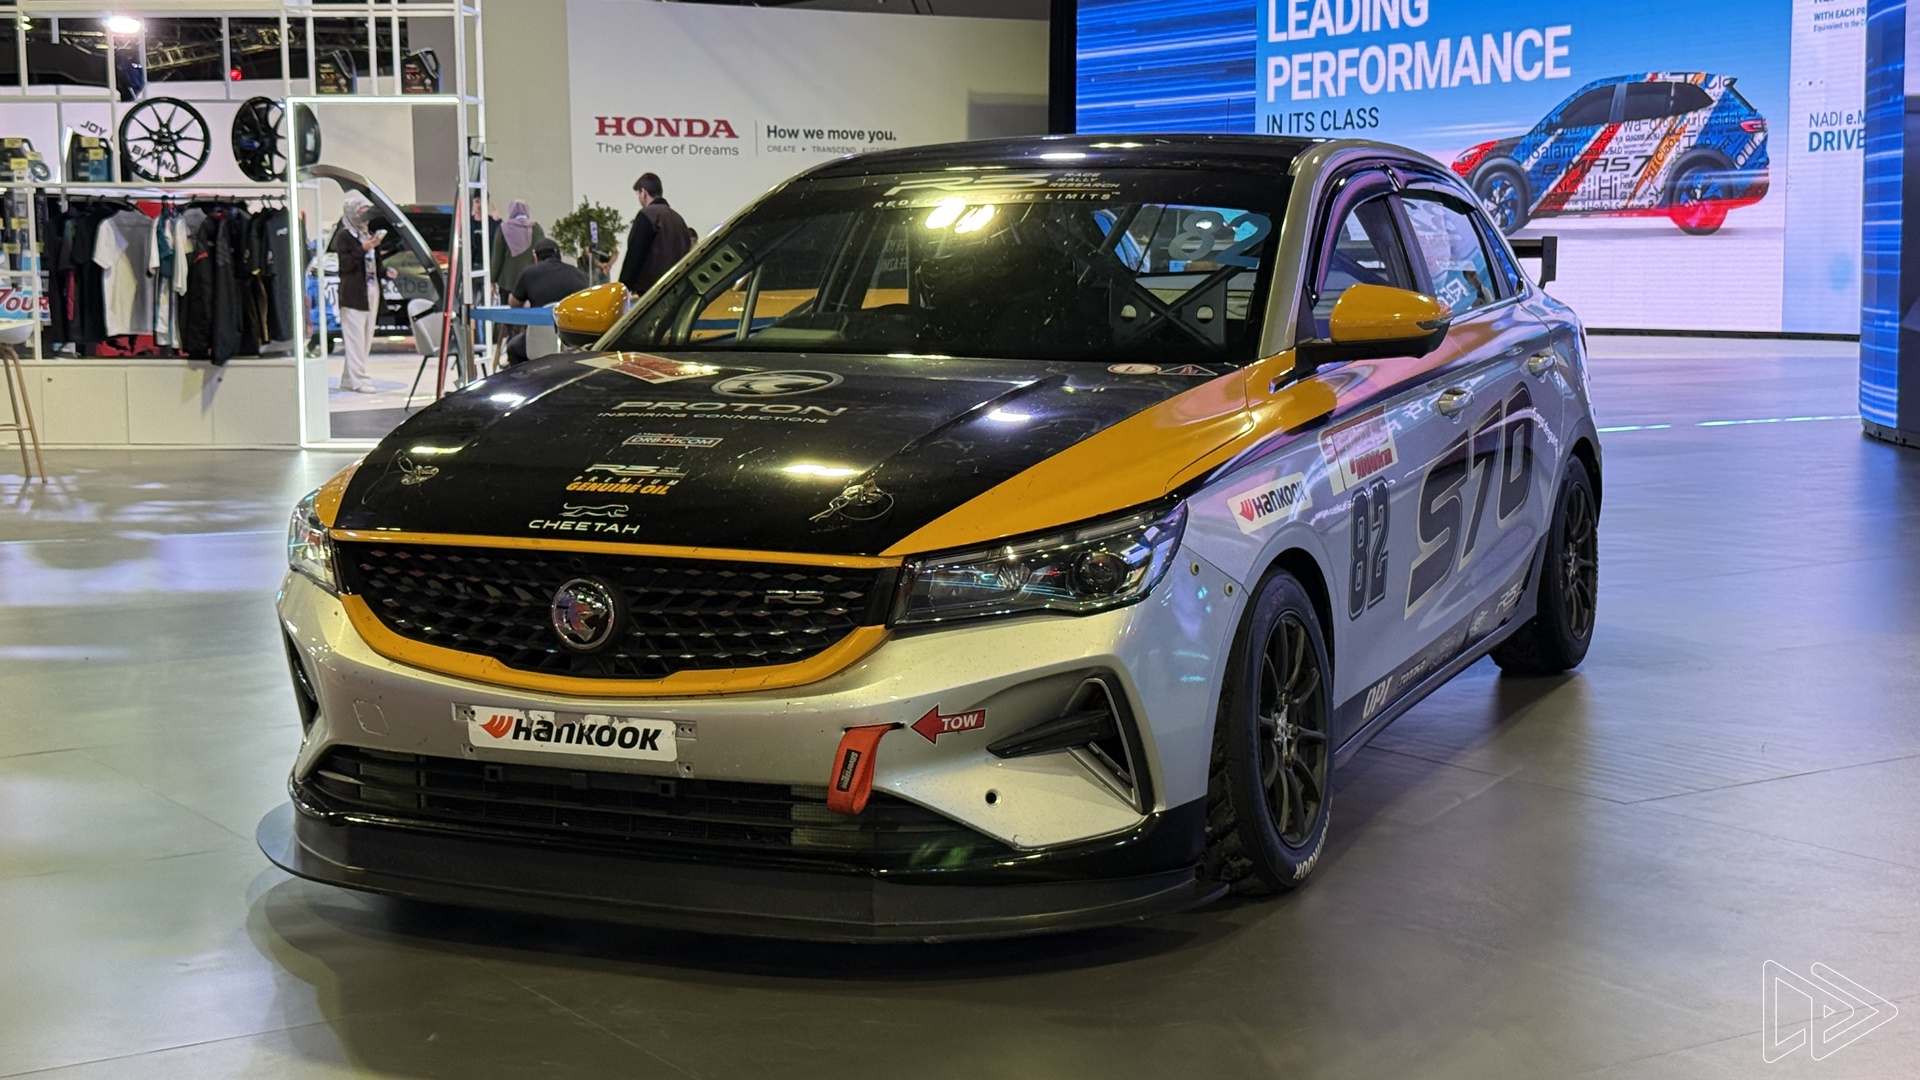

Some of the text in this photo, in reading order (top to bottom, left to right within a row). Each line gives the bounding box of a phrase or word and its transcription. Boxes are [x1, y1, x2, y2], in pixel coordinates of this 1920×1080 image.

[1267, 0, 1429, 43] LEADING
[1814, 11, 1834, 21] WITH
[1835, 9, 1855, 18] EACH
[1267, 25, 1572, 103] PERFORMANCE
[594, 116, 739, 139] HONDA
[1266, 107, 1379, 134] IN ITS CLASS
[1808, 111, 1842, 128] NADI
[80, 121, 107, 136] JOY
[766, 125, 897, 143] How we move you.
[596, 142, 739, 156] The Power of Dreams
[1808, 129, 1866, 153] DRIVE
[1000, 193, 1034, 201] THE
[611, 401, 849, 416] PROTON
[693, 413, 829, 424] CONNECTIONS
[631, 437, 715, 446] DRB-HICOM
[565, 481, 671, 496] GENUINE OIL
[573, 475, 680, 486] PREMIUM
[1404, 381, 1534, 620] S70
[528, 519, 641, 534] CHEETAH
[1349, 475, 1391, 622] 82
[941, 712, 978, 731] TOW
